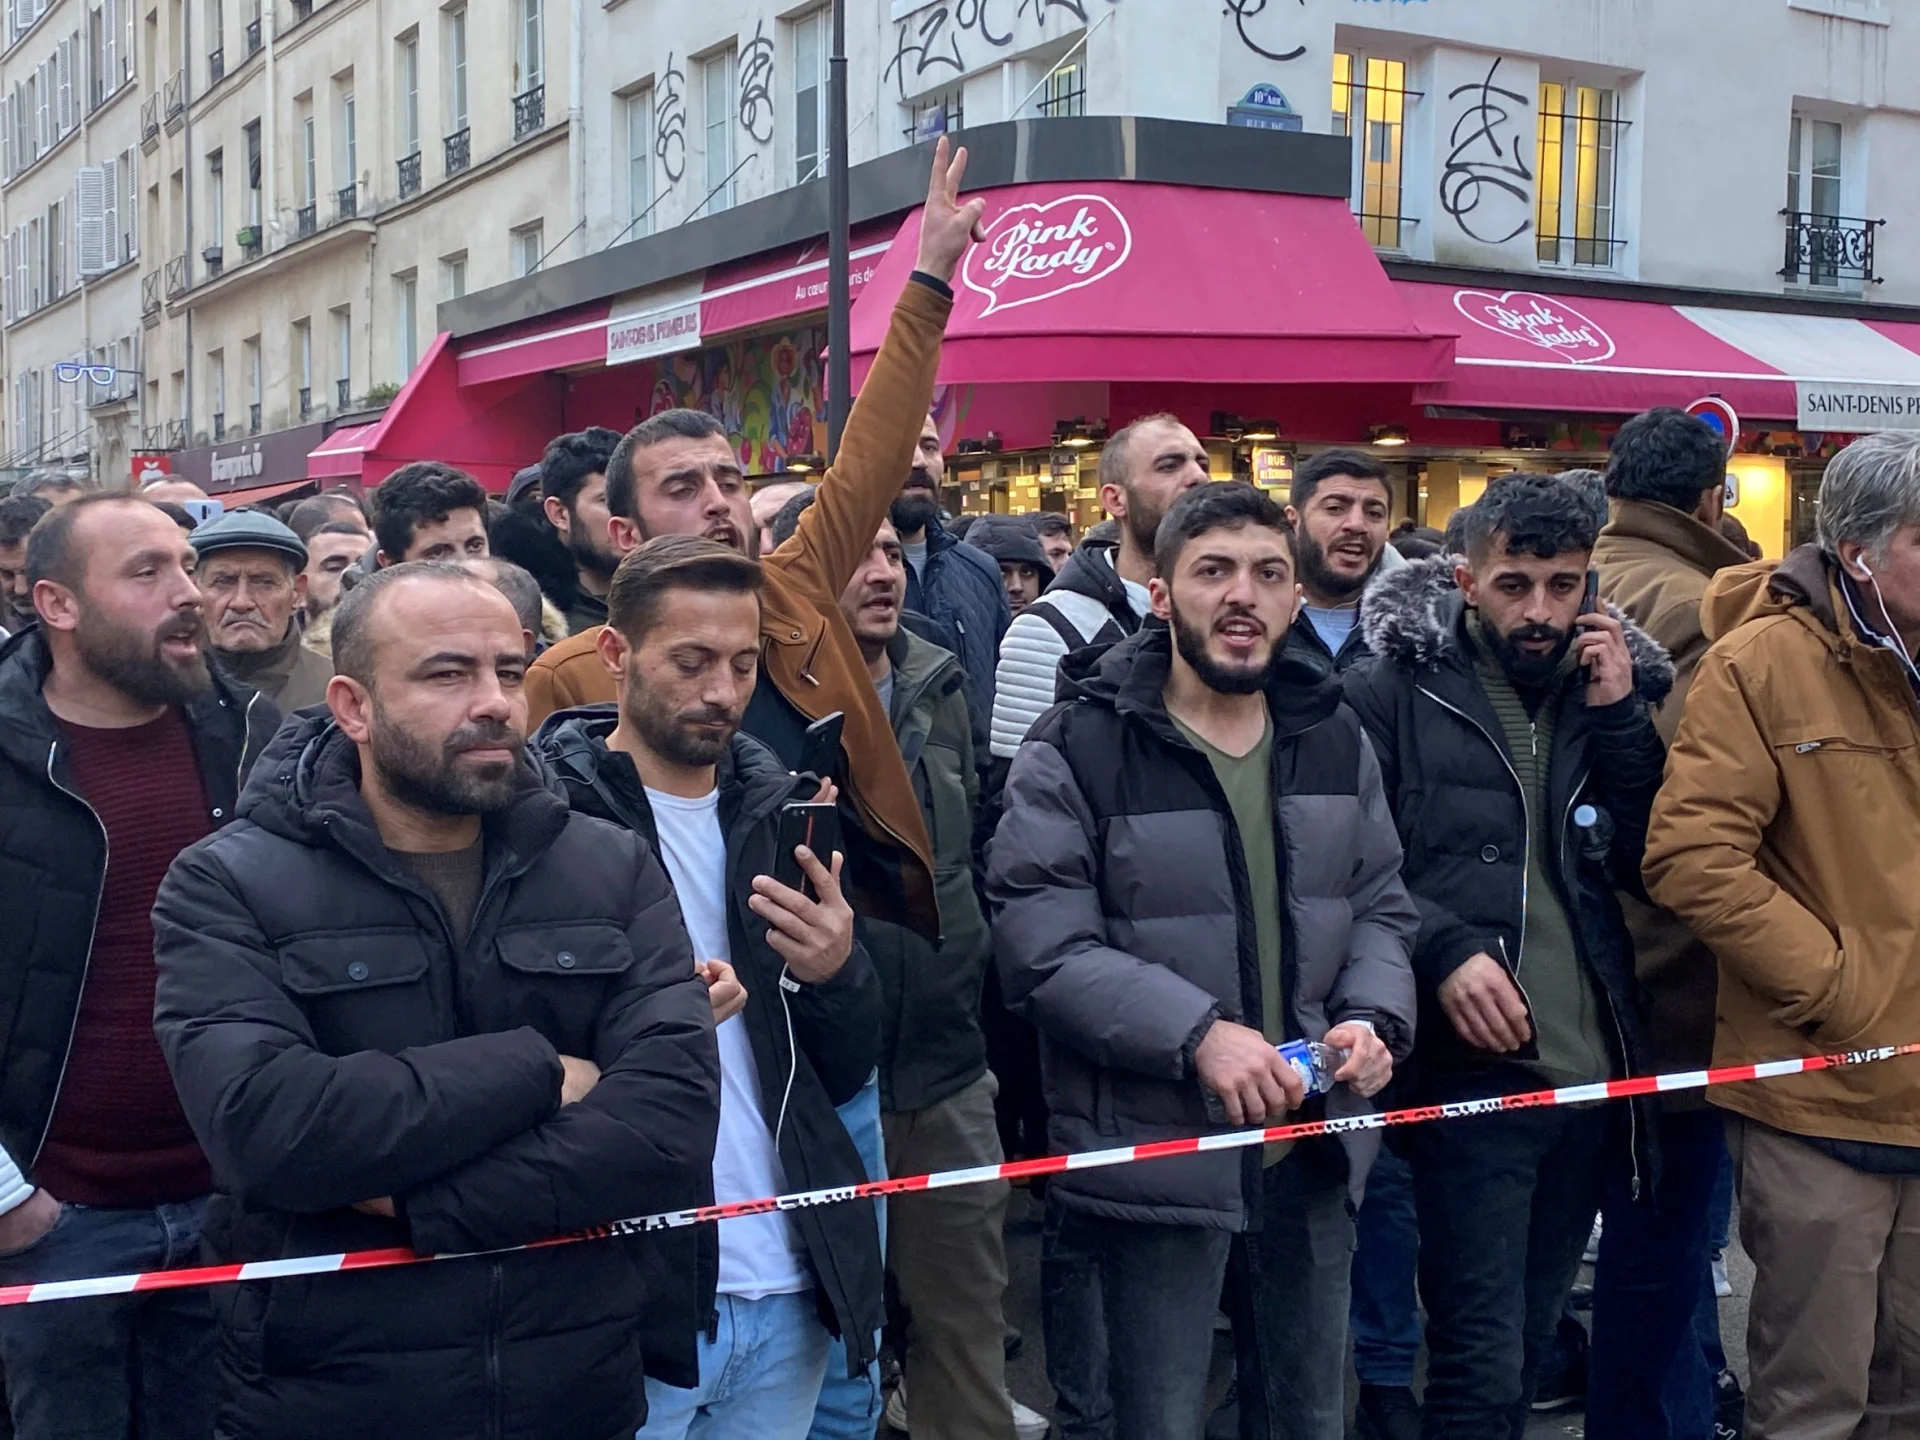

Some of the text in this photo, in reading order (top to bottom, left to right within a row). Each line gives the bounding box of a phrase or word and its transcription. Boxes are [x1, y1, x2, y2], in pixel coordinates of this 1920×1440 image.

[992, 206, 1098, 257] Pink
[983, 238, 1104, 288] Lady
[795, 284, 806, 300] Au
[1484, 300, 1563, 331] Pink
[1807, 393, 1903, 415] SAINT-DENIS
